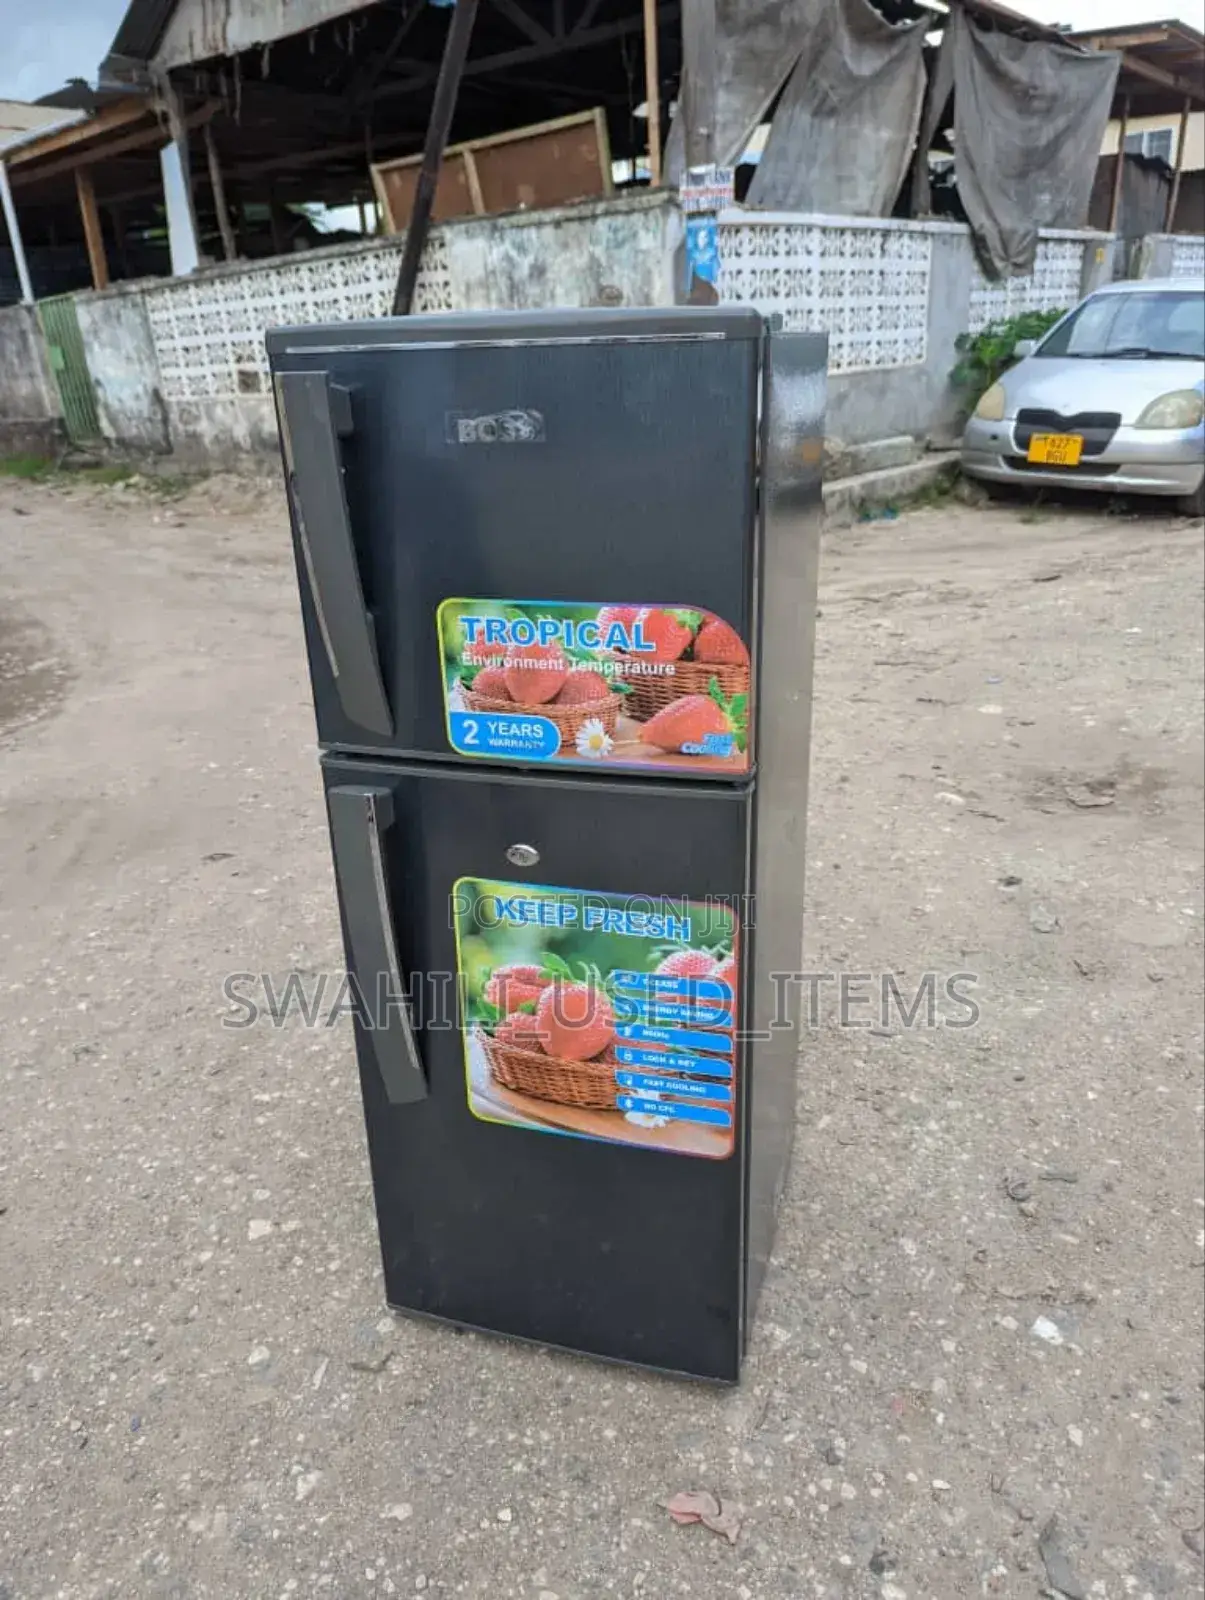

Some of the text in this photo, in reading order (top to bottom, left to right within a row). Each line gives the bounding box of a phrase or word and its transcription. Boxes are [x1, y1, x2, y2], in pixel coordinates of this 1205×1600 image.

[459, 615, 656, 651] TROPICAL
[462, 651, 675, 676] Environment Temperature
[463, 719, 544, 745] 2 YEARS
[495, 896, 691, 942] KEEP FRESH
